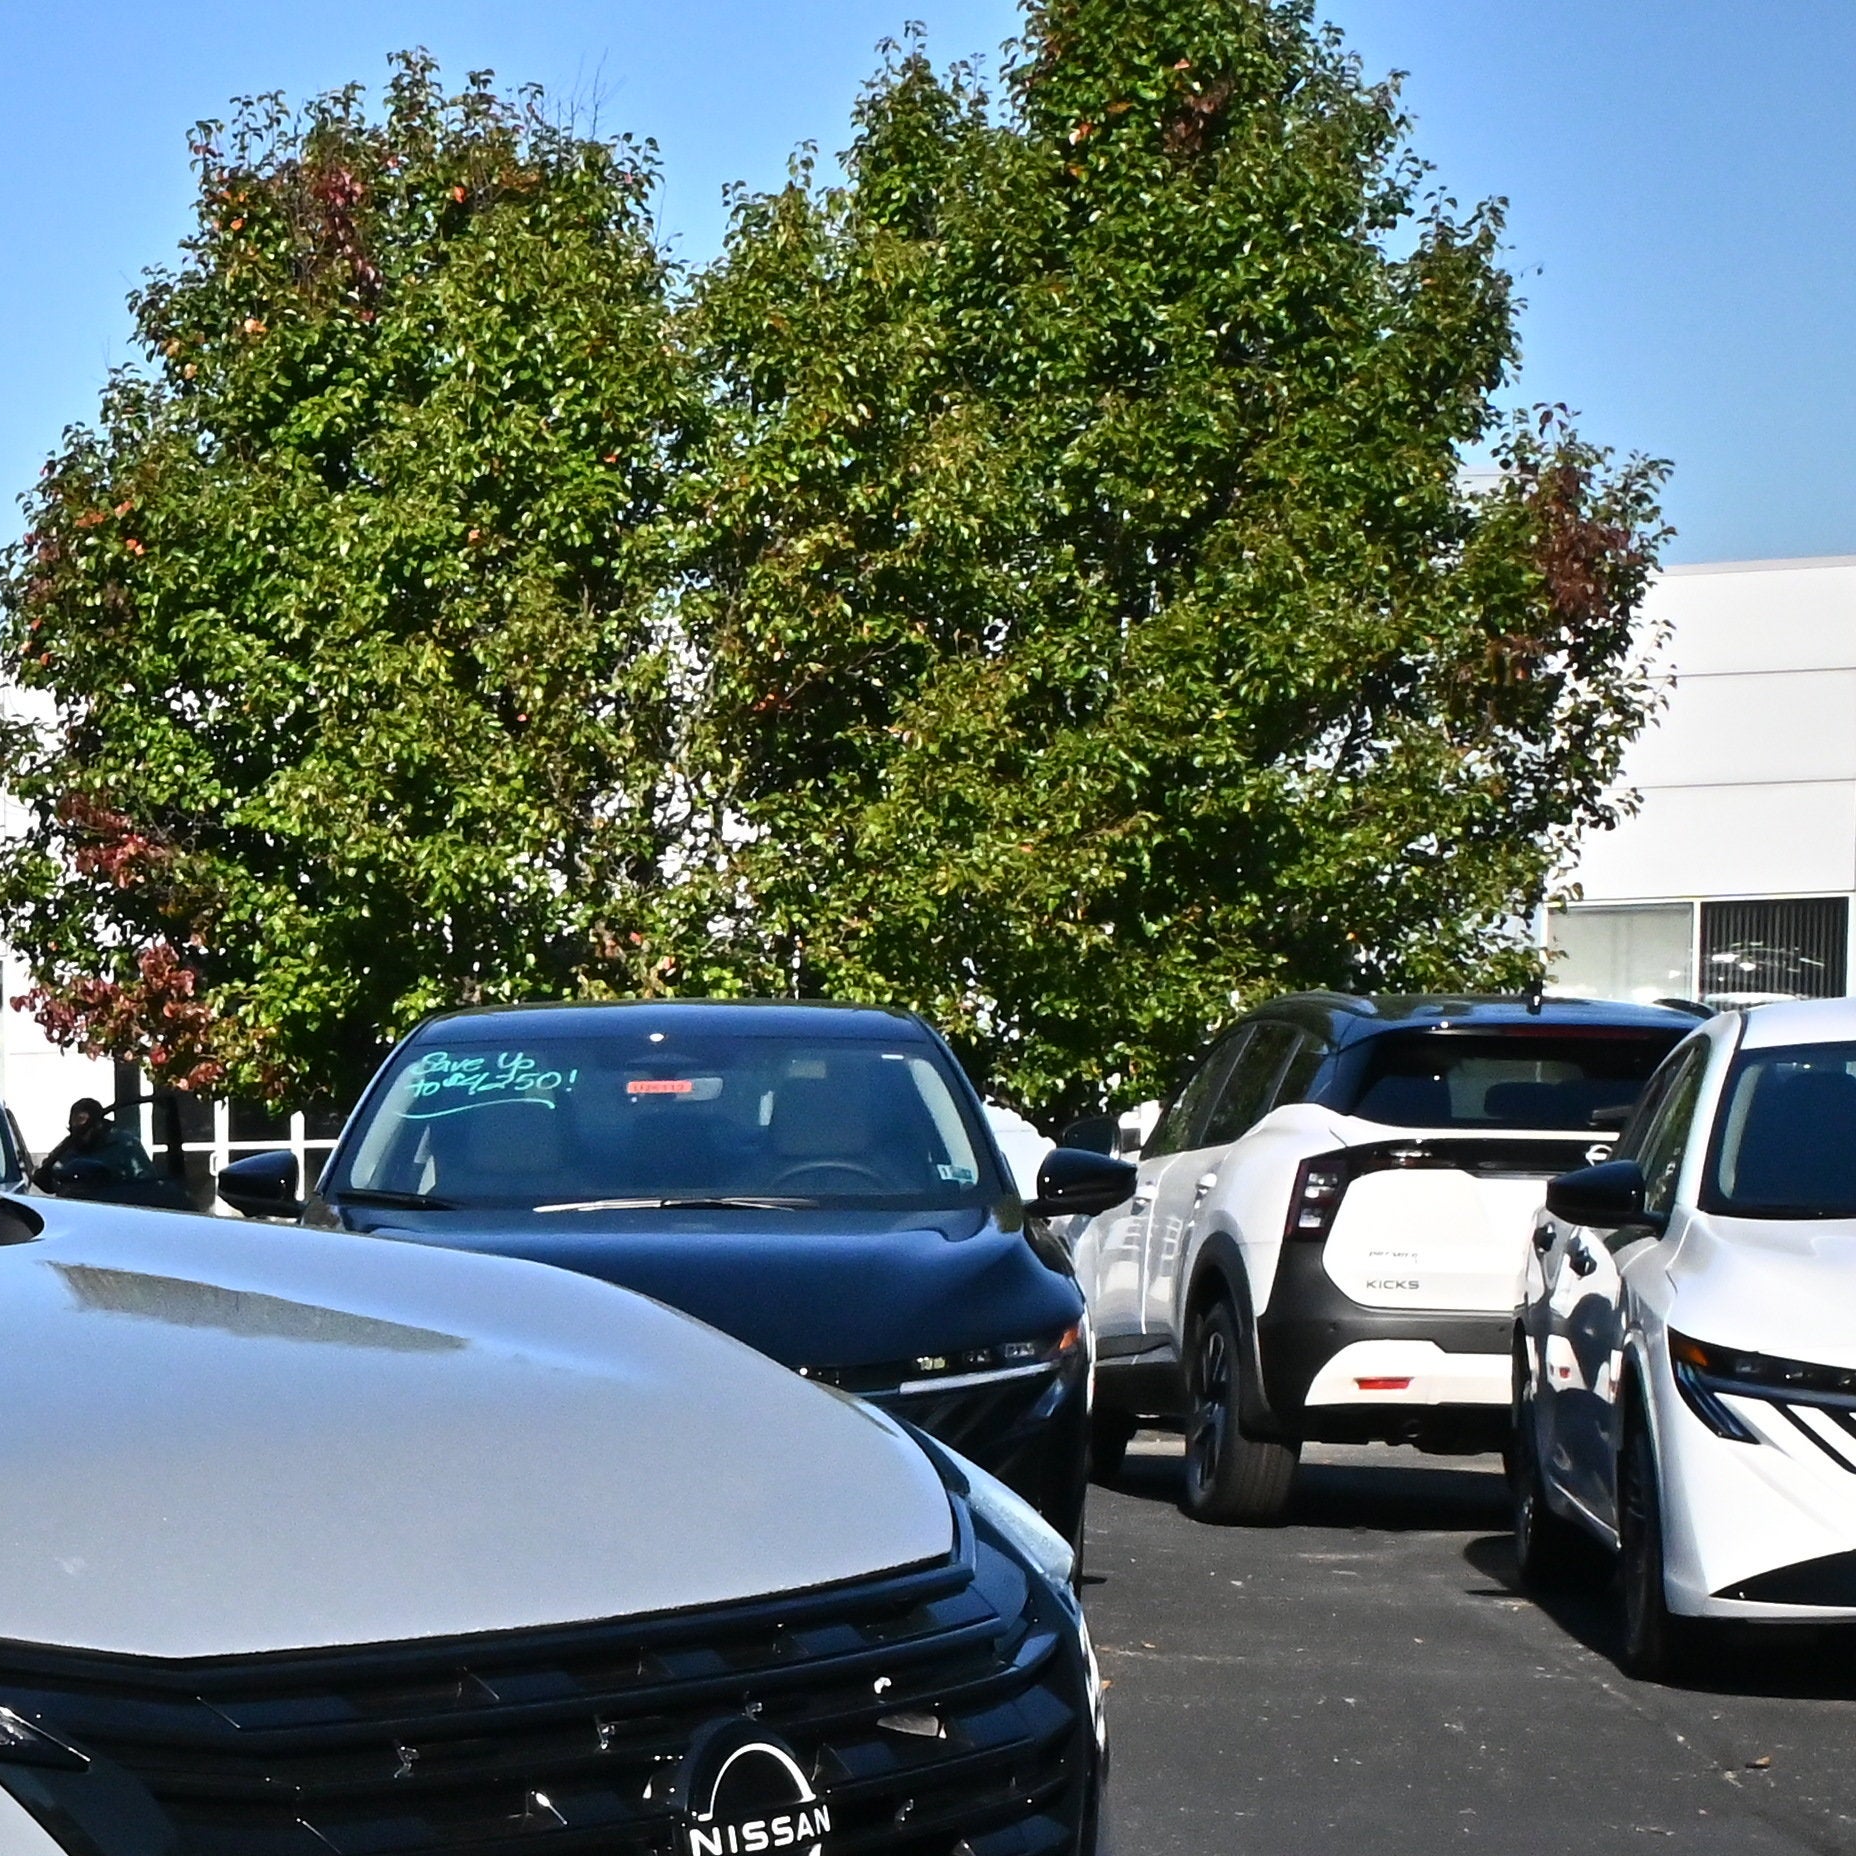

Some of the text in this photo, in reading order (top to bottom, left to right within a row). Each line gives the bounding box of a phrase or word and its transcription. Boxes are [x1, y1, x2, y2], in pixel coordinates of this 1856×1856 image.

[409, 1052, 485, 1074] Save
[405, 1079, 440, 1097] to
[1366, 1280, 1420, 1290] KICKS
